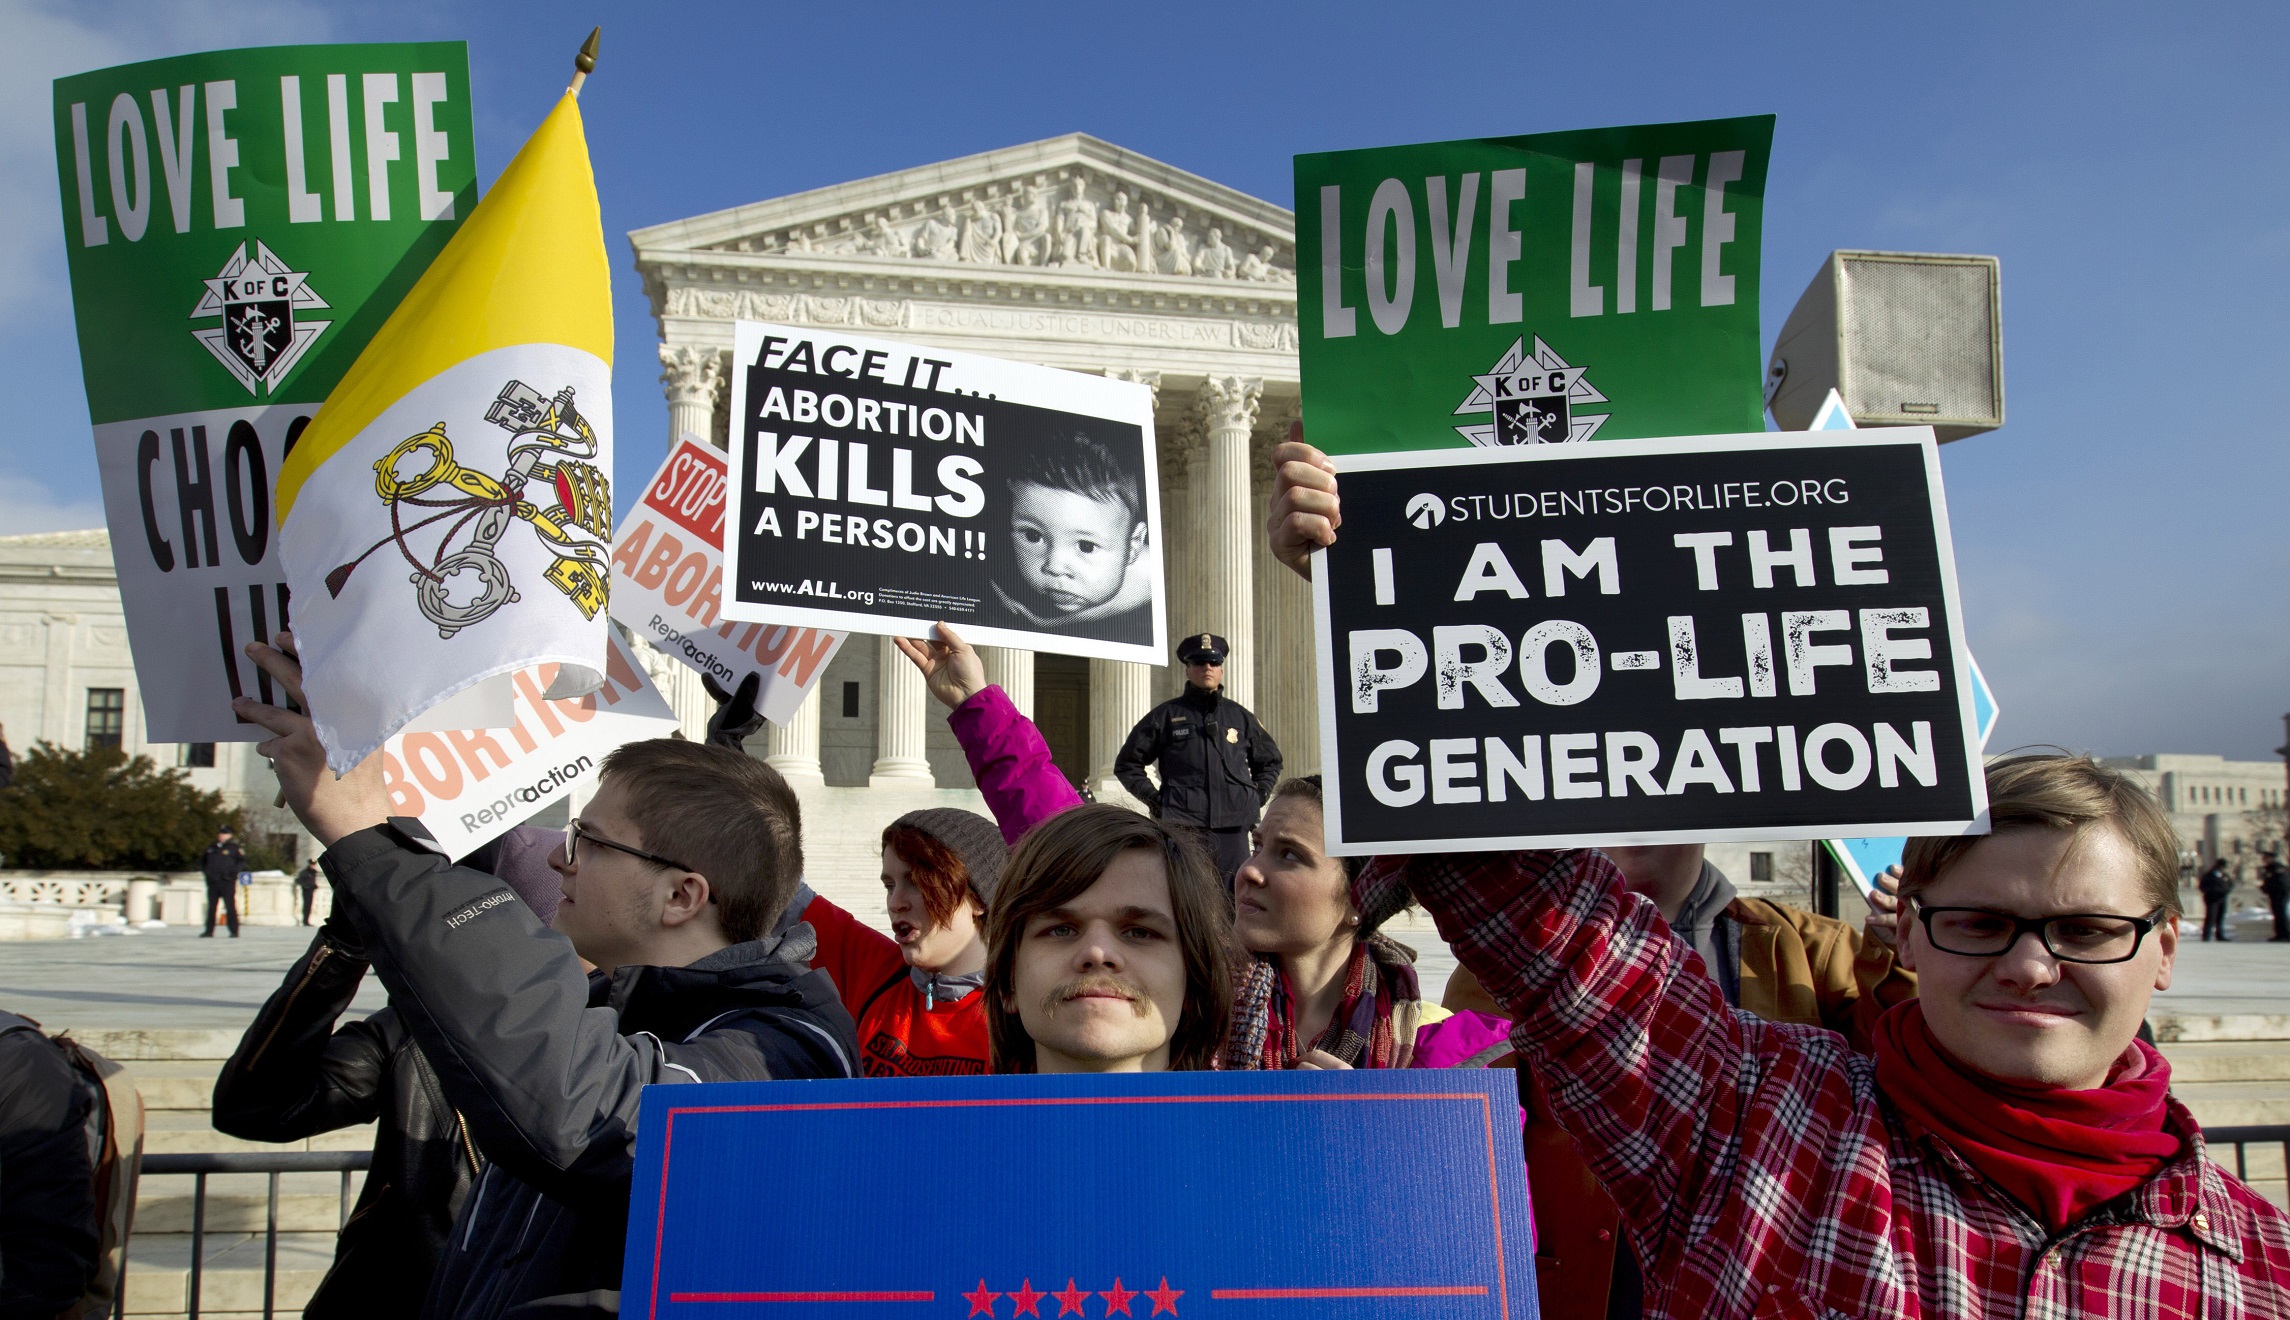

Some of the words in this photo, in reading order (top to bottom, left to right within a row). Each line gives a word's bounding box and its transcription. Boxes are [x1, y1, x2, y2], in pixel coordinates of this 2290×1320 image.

[71, 79, 246, 248] LOVE
[280, 72, 456, 223] LIFE
[1320, 167, 1527, 339] LOVE
[1570, 149, 1746, 319] LIFE
[223, 279, 241, 302] K
[244, 280, 266, 296] OF
[272, 277, 290, 299] C
[924, 308, 998, 329] EQUAL
[1006, 314, 1089, 334] JUSTICE
[1101, 319, 1171, 340] UNDER
[1180, 324, 1221, 341] LAW
[755, 335, 889, 381] FACE
[1495, 375, 1514, 399] K
[1518, 376, 1542, 393] OF
[1548, 371, 1567, 394] C
[759, 386, 986, 448] ABORTION
[137, 415, 312, 574] CHO
[655, 452, 728, 522] STOP
[755, 431, 987, 519] KILLS
[1450, 478, 1850, 523] STUDENTSFORLIFE.ORG
[754, 506, 783, 538] A
[797, 510, 987, 561] PERSON!!
[1373, 547, 1396, 606] I
[1454, 536, 1621, 602] AM
[1674, 525, 1890, 591] THE
[751, 577, 875, 606] www.ALL.org
[647, 613, 734, 683] Reproaction
[1349, 606, 1941, 714] PRO-LIFE
[1172, 728, 1189, 737] POLICE
[1365, 720, 1938, 808] GENERATION
[459, 755, 594, 835] Reproaction
[446, 892, 516, 929] HYDRO-TECH
